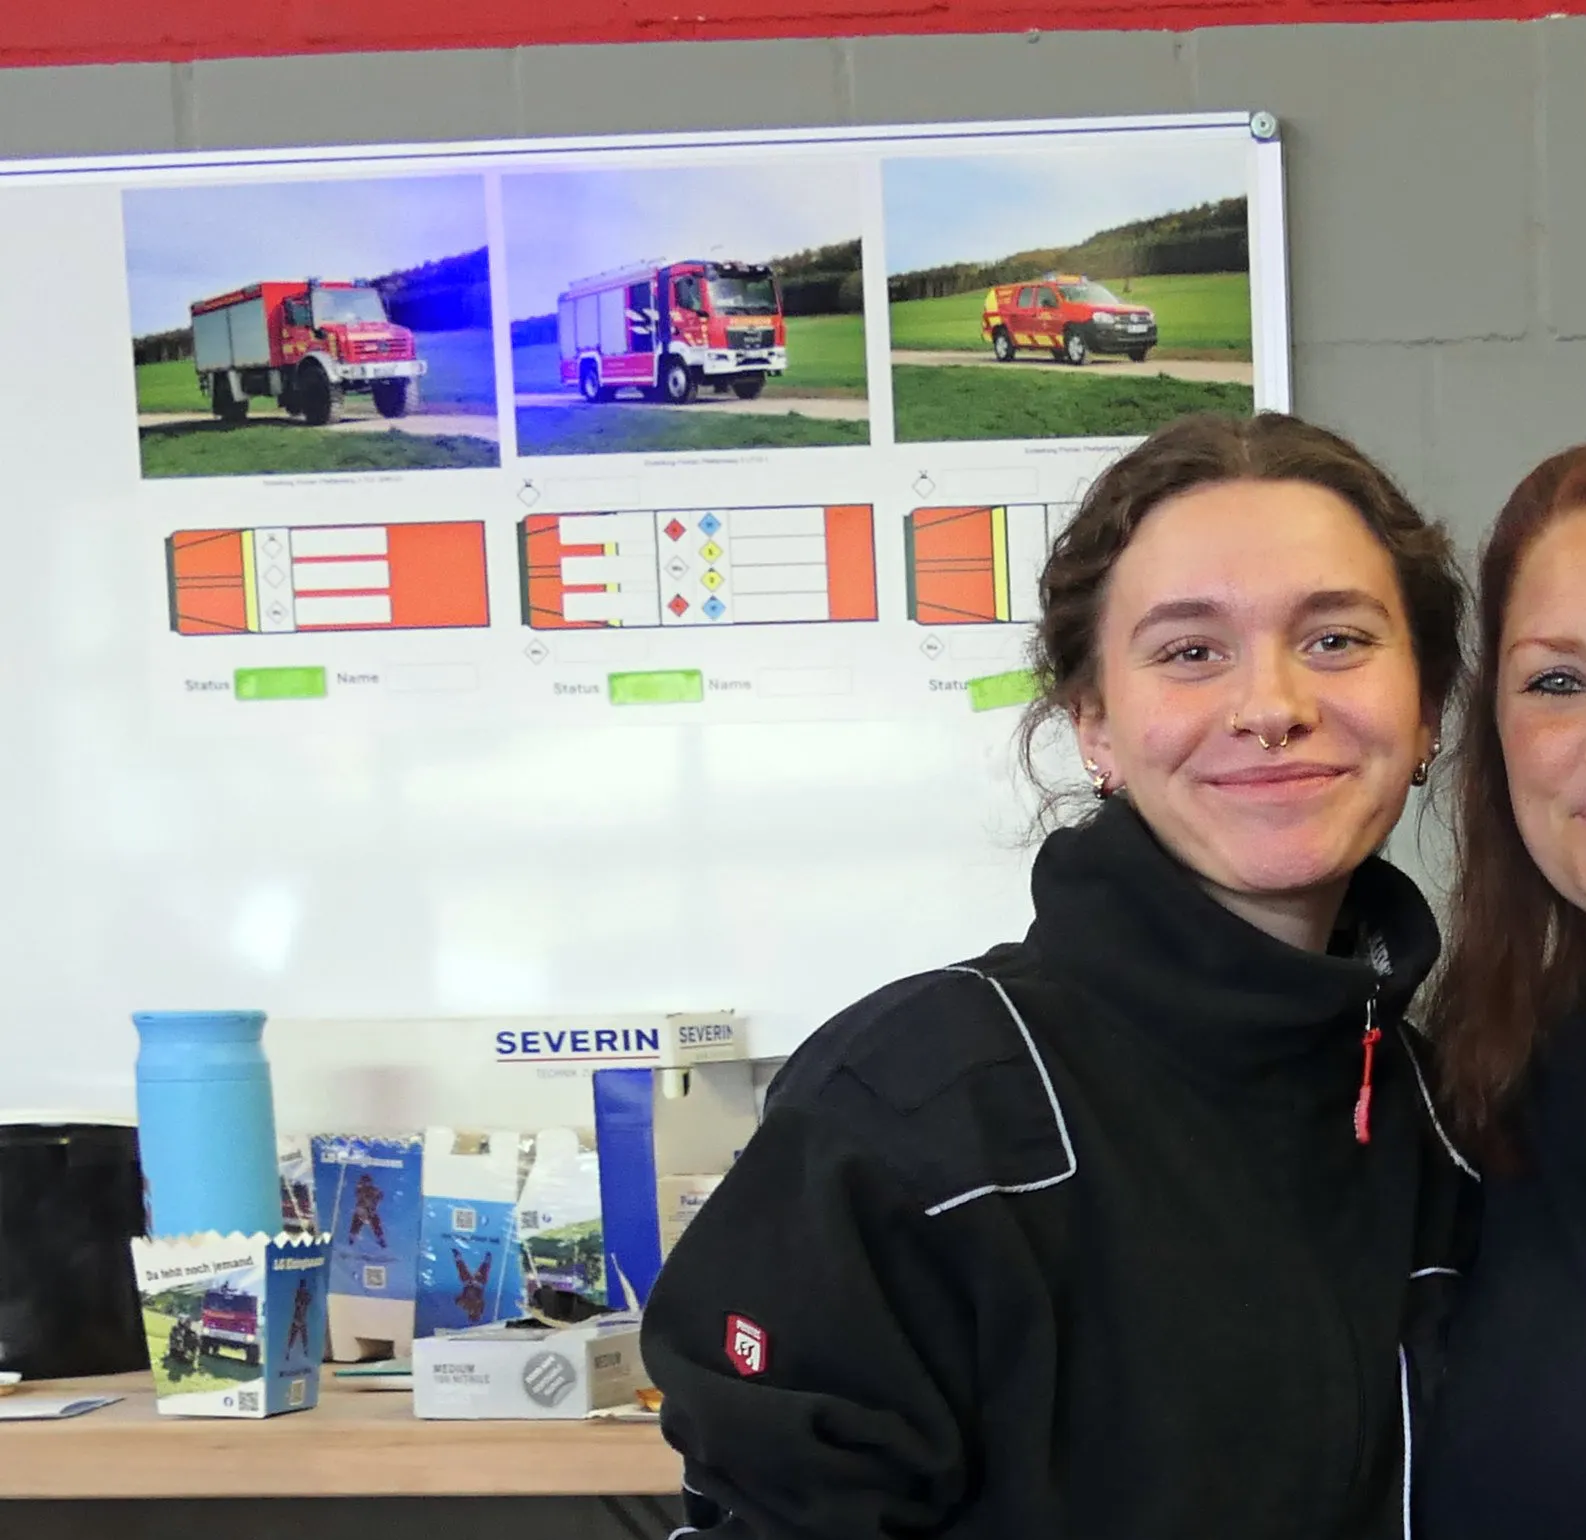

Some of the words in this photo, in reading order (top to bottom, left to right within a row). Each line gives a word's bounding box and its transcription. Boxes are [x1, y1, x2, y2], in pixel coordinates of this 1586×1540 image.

[185, 679, 230, 692] Status
[337, 673, 380, 684] Name
[553, 682, 600, 695] Status
[708, 679, 752, 691] Name
[495, 1028, 660, 1055] SEVERIN
[678, 1024, 734, 1044] SEVERIN
[184, 1262, 211, 1276] noch
[212, 1255, 254, 1275] jemand
[432, 1363, 475, 1374] MEDIUM
